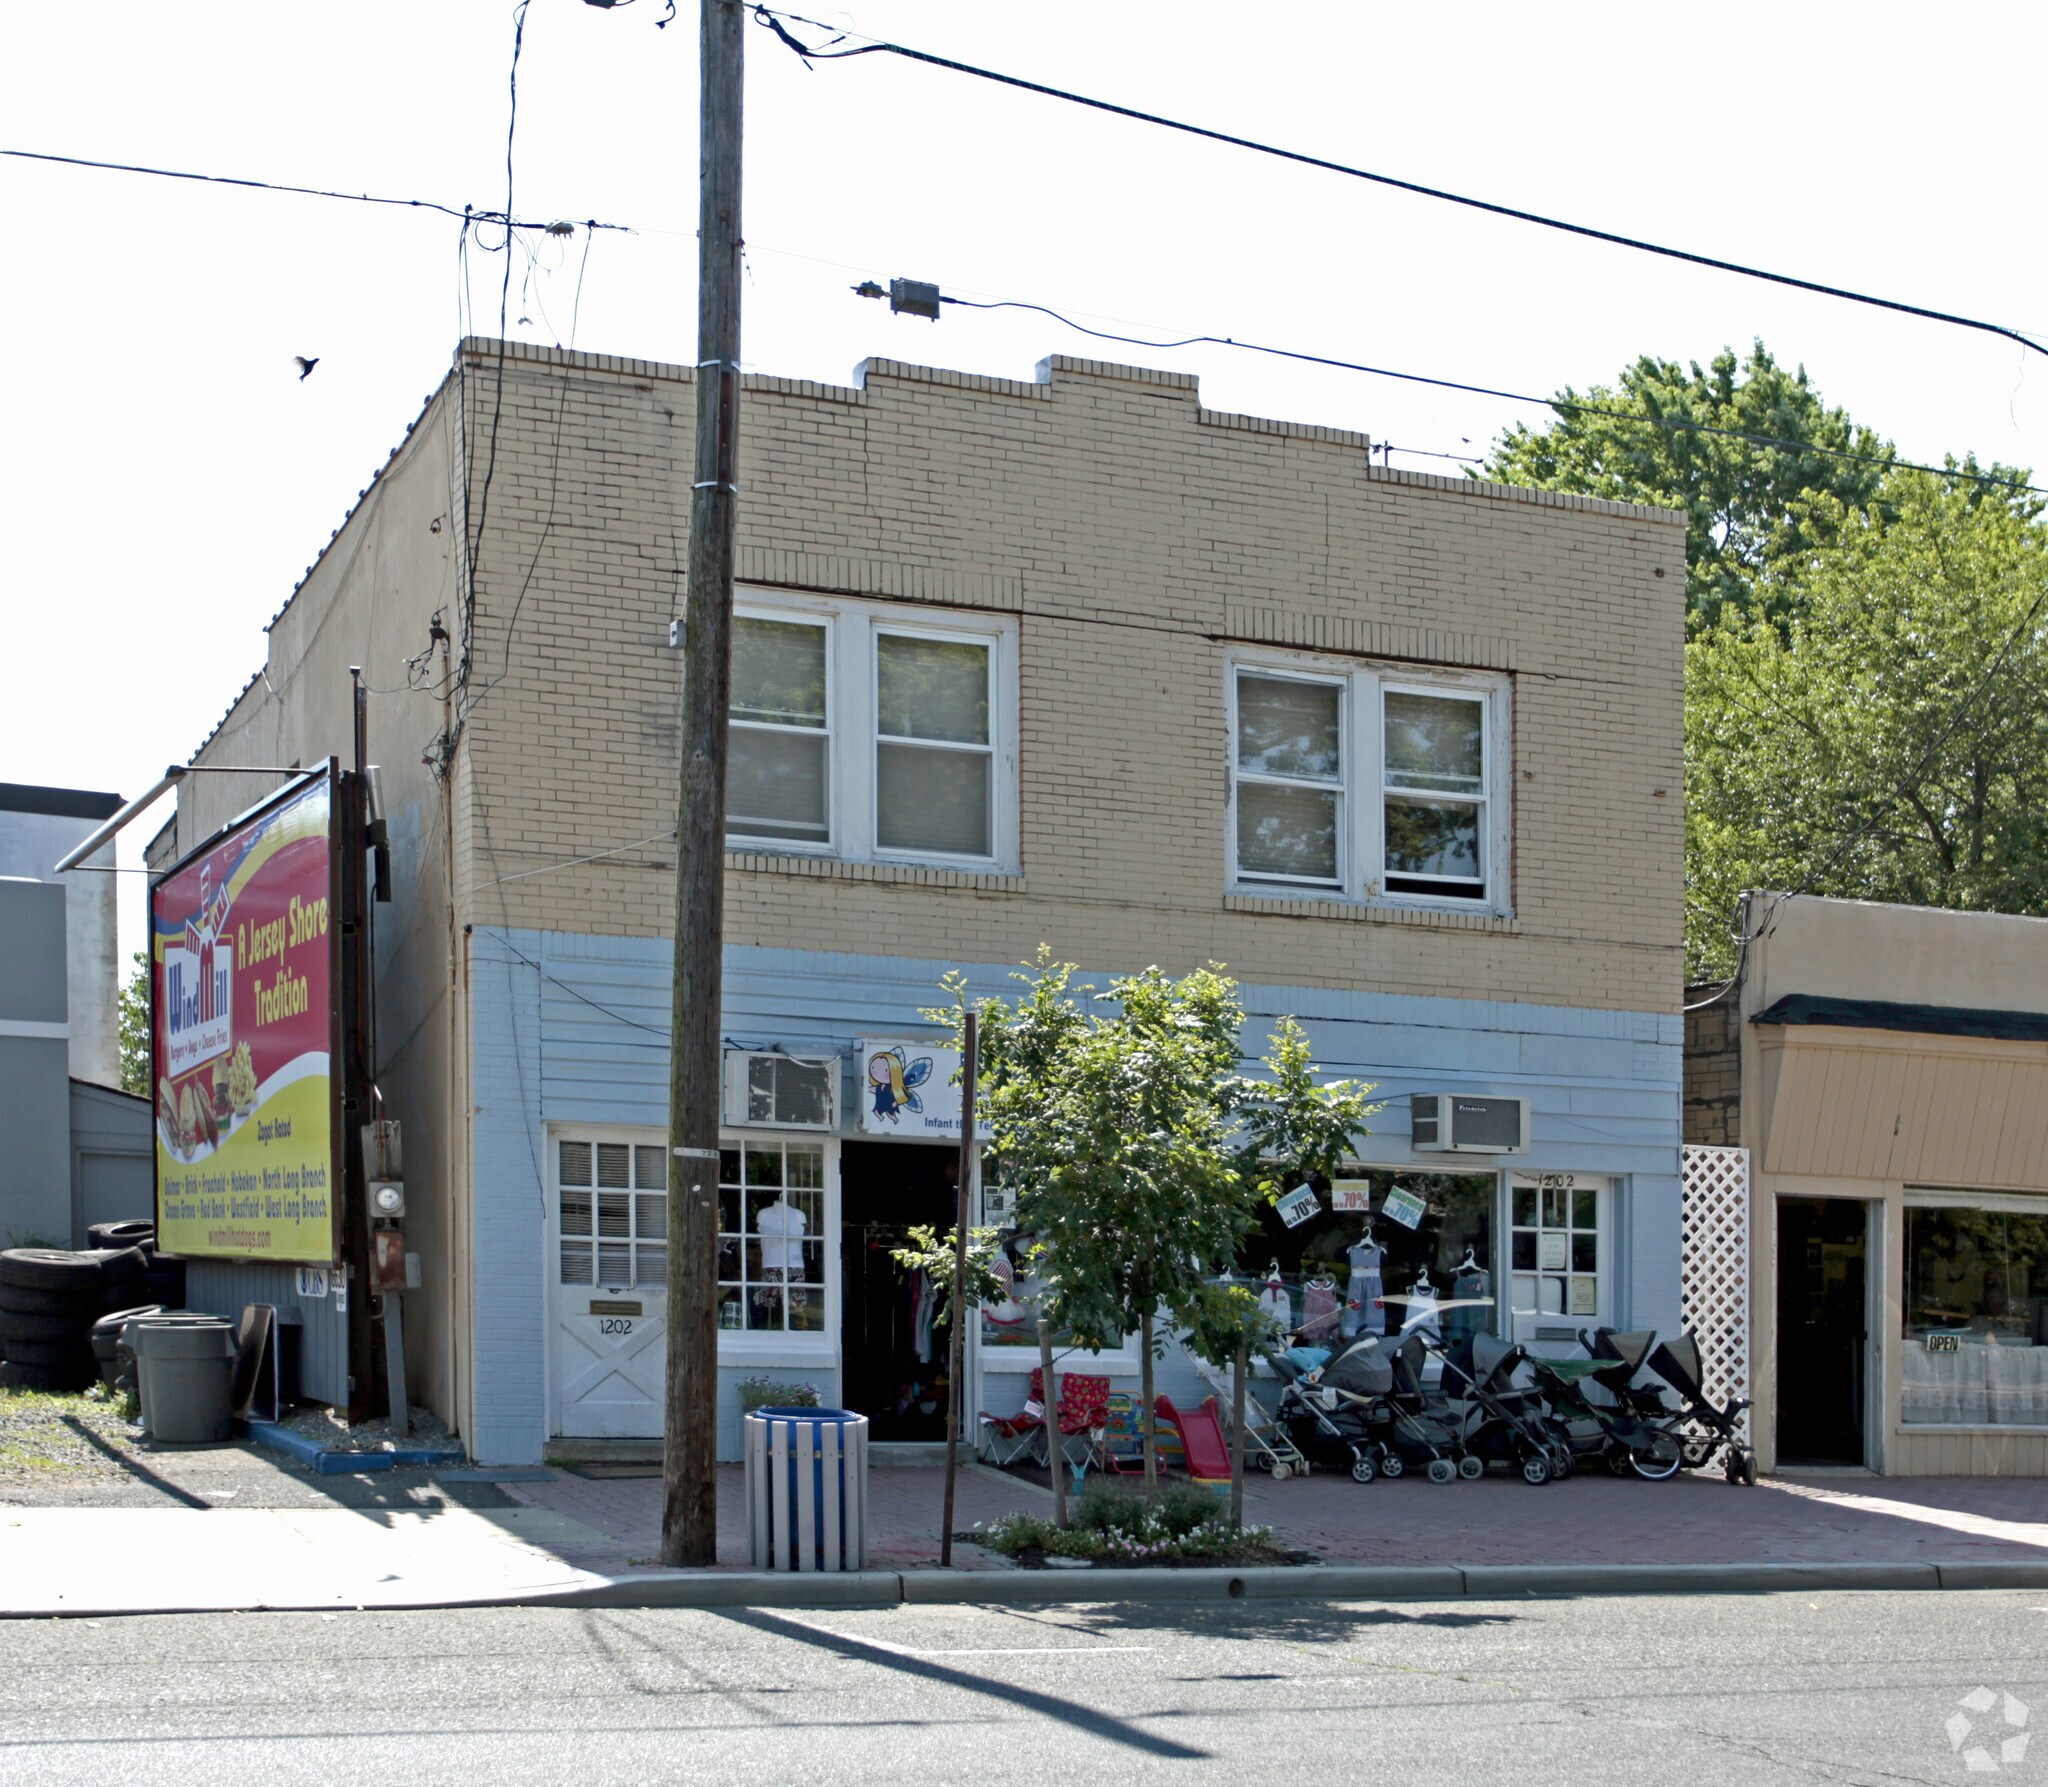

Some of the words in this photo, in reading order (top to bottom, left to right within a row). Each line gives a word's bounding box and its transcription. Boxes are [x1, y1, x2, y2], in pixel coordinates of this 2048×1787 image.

[238, 923, 246, 971] A
[248, 915, 286, 967] Jersey
[289, 894, 328, 949] Shore
[254, 965, 308, 1027] Tradition
[202, 1033, 217, 1050] Cheese
[216, 1027, 228, 1046] Fries
[924, 1117, 953, 1130] Infant
[231, 1169, 258, 1192] Hoboken
[263, 1166, 282, 1191] North
[283, 1165, 300, 1196] Long
[302, 1162, 327, 1189] Branch
[231, 1196, 260, 1219] Westfield
[265, 1195, 282, 1218] West
[284, 1195, 300, 1225] Long
[302, 1193, 328, 1219] Branch
[1290, 1195, 1320, 1220] 70%
[1343, 1192, 1369, 1209] 70%
[1393, 1202, 1418, 1227] 70%
[600, 1319, 633, 1335] 1202
[1930, 1335, 1959, 1351] OPEN
